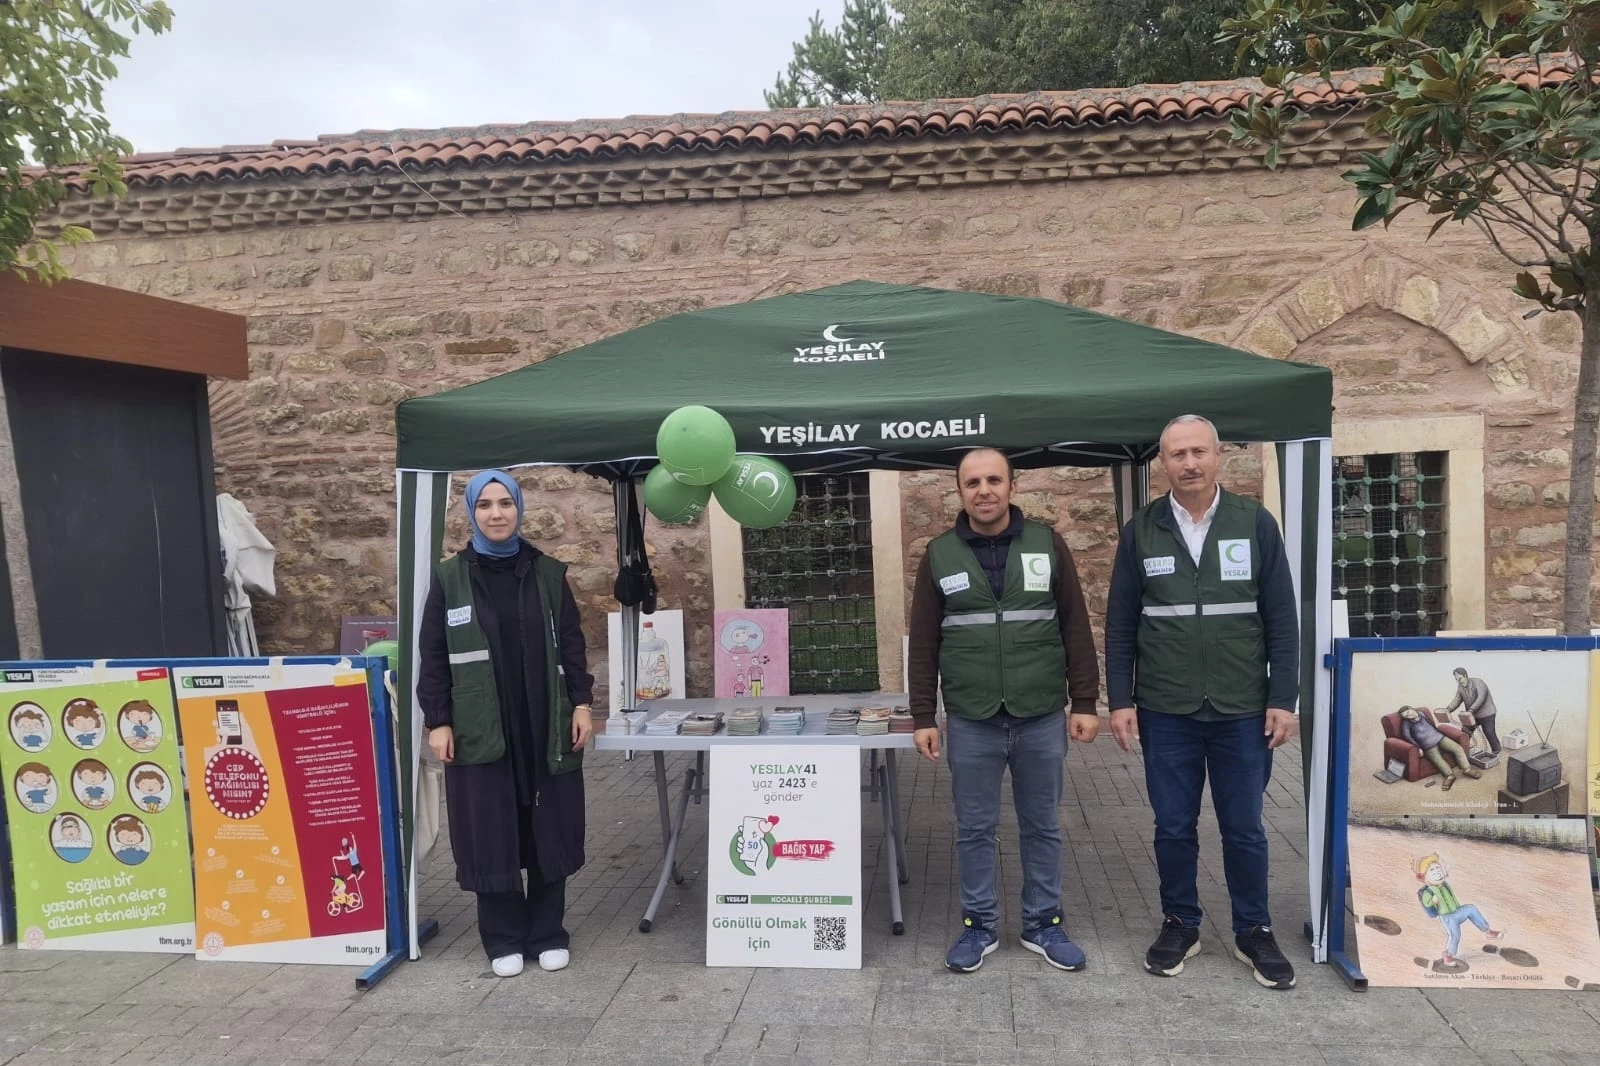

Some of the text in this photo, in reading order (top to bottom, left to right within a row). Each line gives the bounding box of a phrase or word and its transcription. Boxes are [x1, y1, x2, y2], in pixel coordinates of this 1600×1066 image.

[795, 341, 885, 356] YEŞİLAY
[793, 349, 886, 363] KOCAELİ
[760, 413, 986, 446] YEŞİLAY KOCAELİ
[226, 764, 244, 772] CEP
[212, 772, 260, 781] TELEFONU
[752, 780, 773, 791] yaz
[763, 792, 804, 804] gönder
[747, 841, 759, 850] 50
[782, 842, 826, 857] BAĞIŞ YAP
[66, 871, 134, 895] Sağlıklı bir
[41, 898, 88, 916] yaşam
[117, 888, 167, 904] nelere
[47, 902, 167, 930] dikkat etmeliyiz?
[712, 917, 807, 929] Gönüllü Olmak
[159, 937, 192, 947] tbm.org.tr
[748, 938, 771, 951] için
[345, 945, 381, 955] tbm.org.tr
